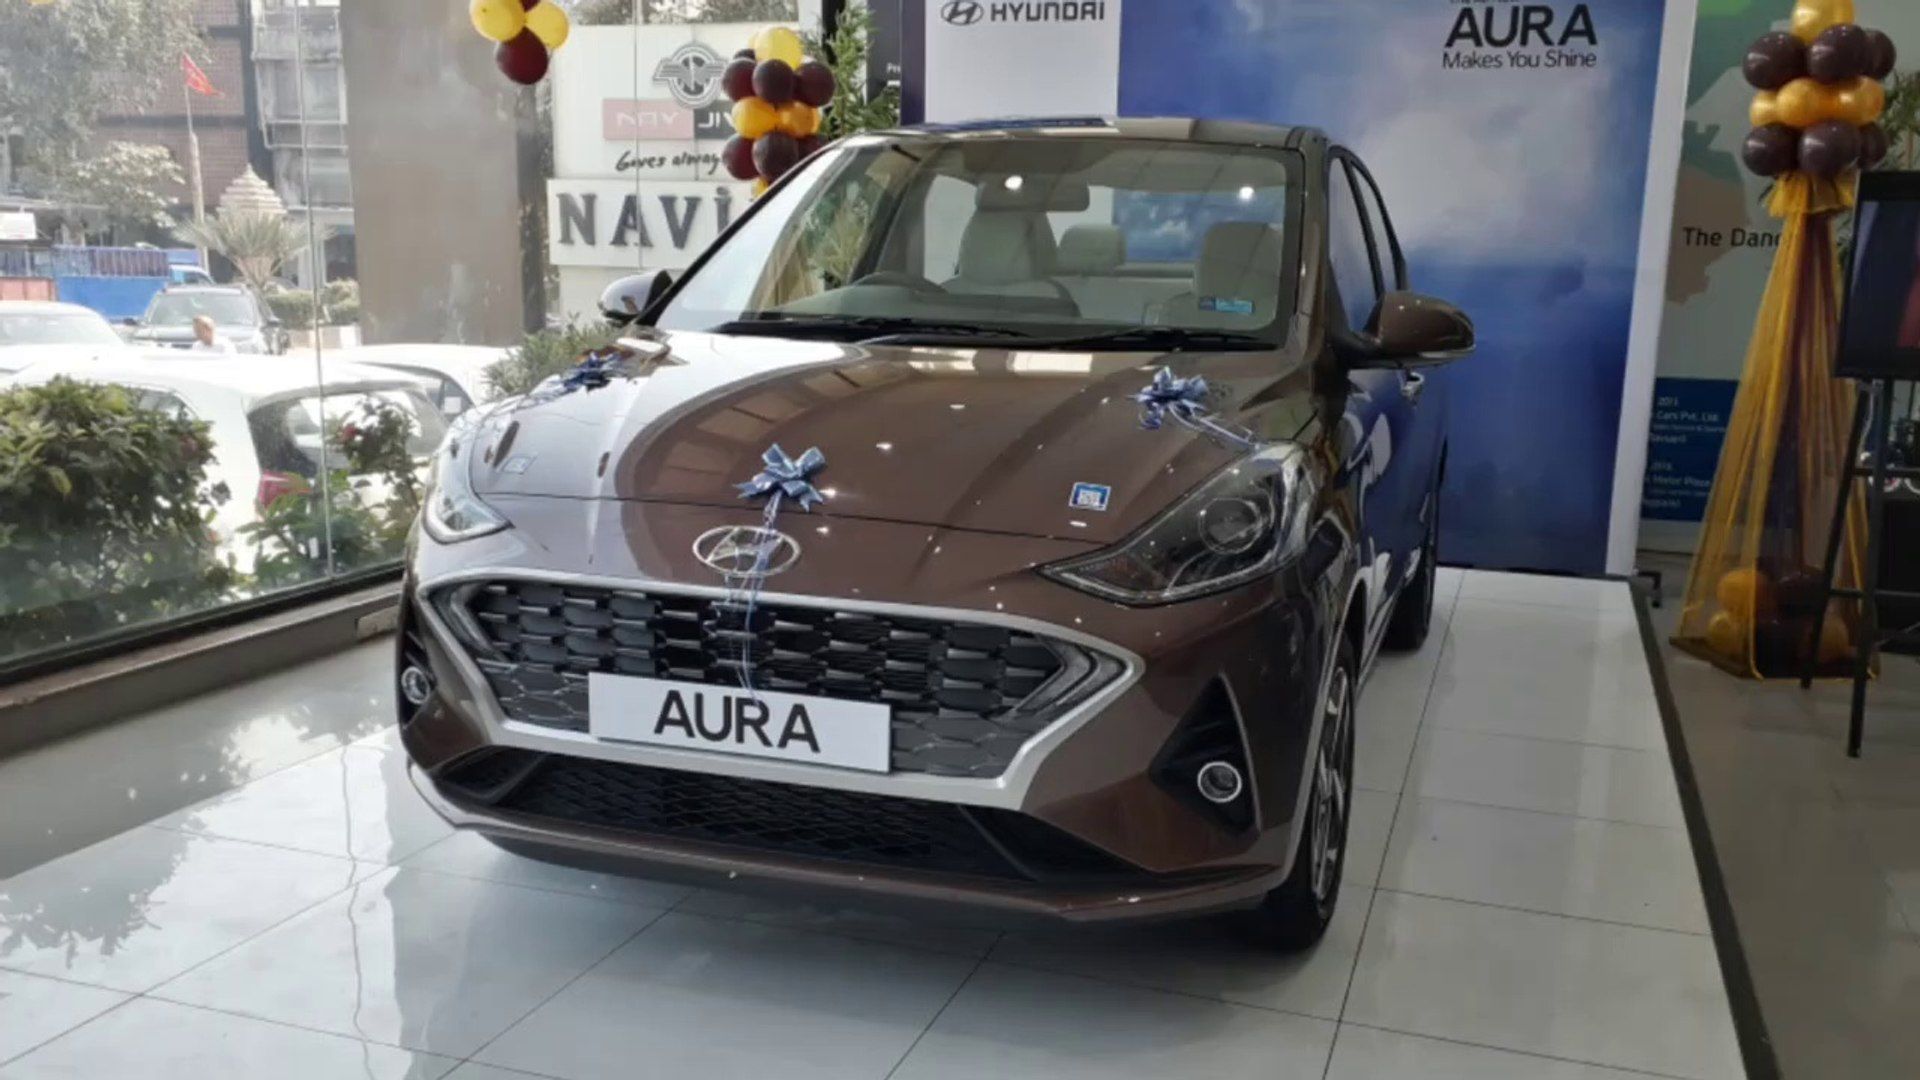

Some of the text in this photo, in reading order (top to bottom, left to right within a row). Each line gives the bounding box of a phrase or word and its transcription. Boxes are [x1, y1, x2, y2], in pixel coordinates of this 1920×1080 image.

[990, 1, 1104, 22] HYUNDAI
[1444, 3, 1598, 48] AURA
[1442, 48, 1598, 69] Makes You Shine
[1682, 227, 1723, 247] The
[653, 689, 822, 754] AURA
